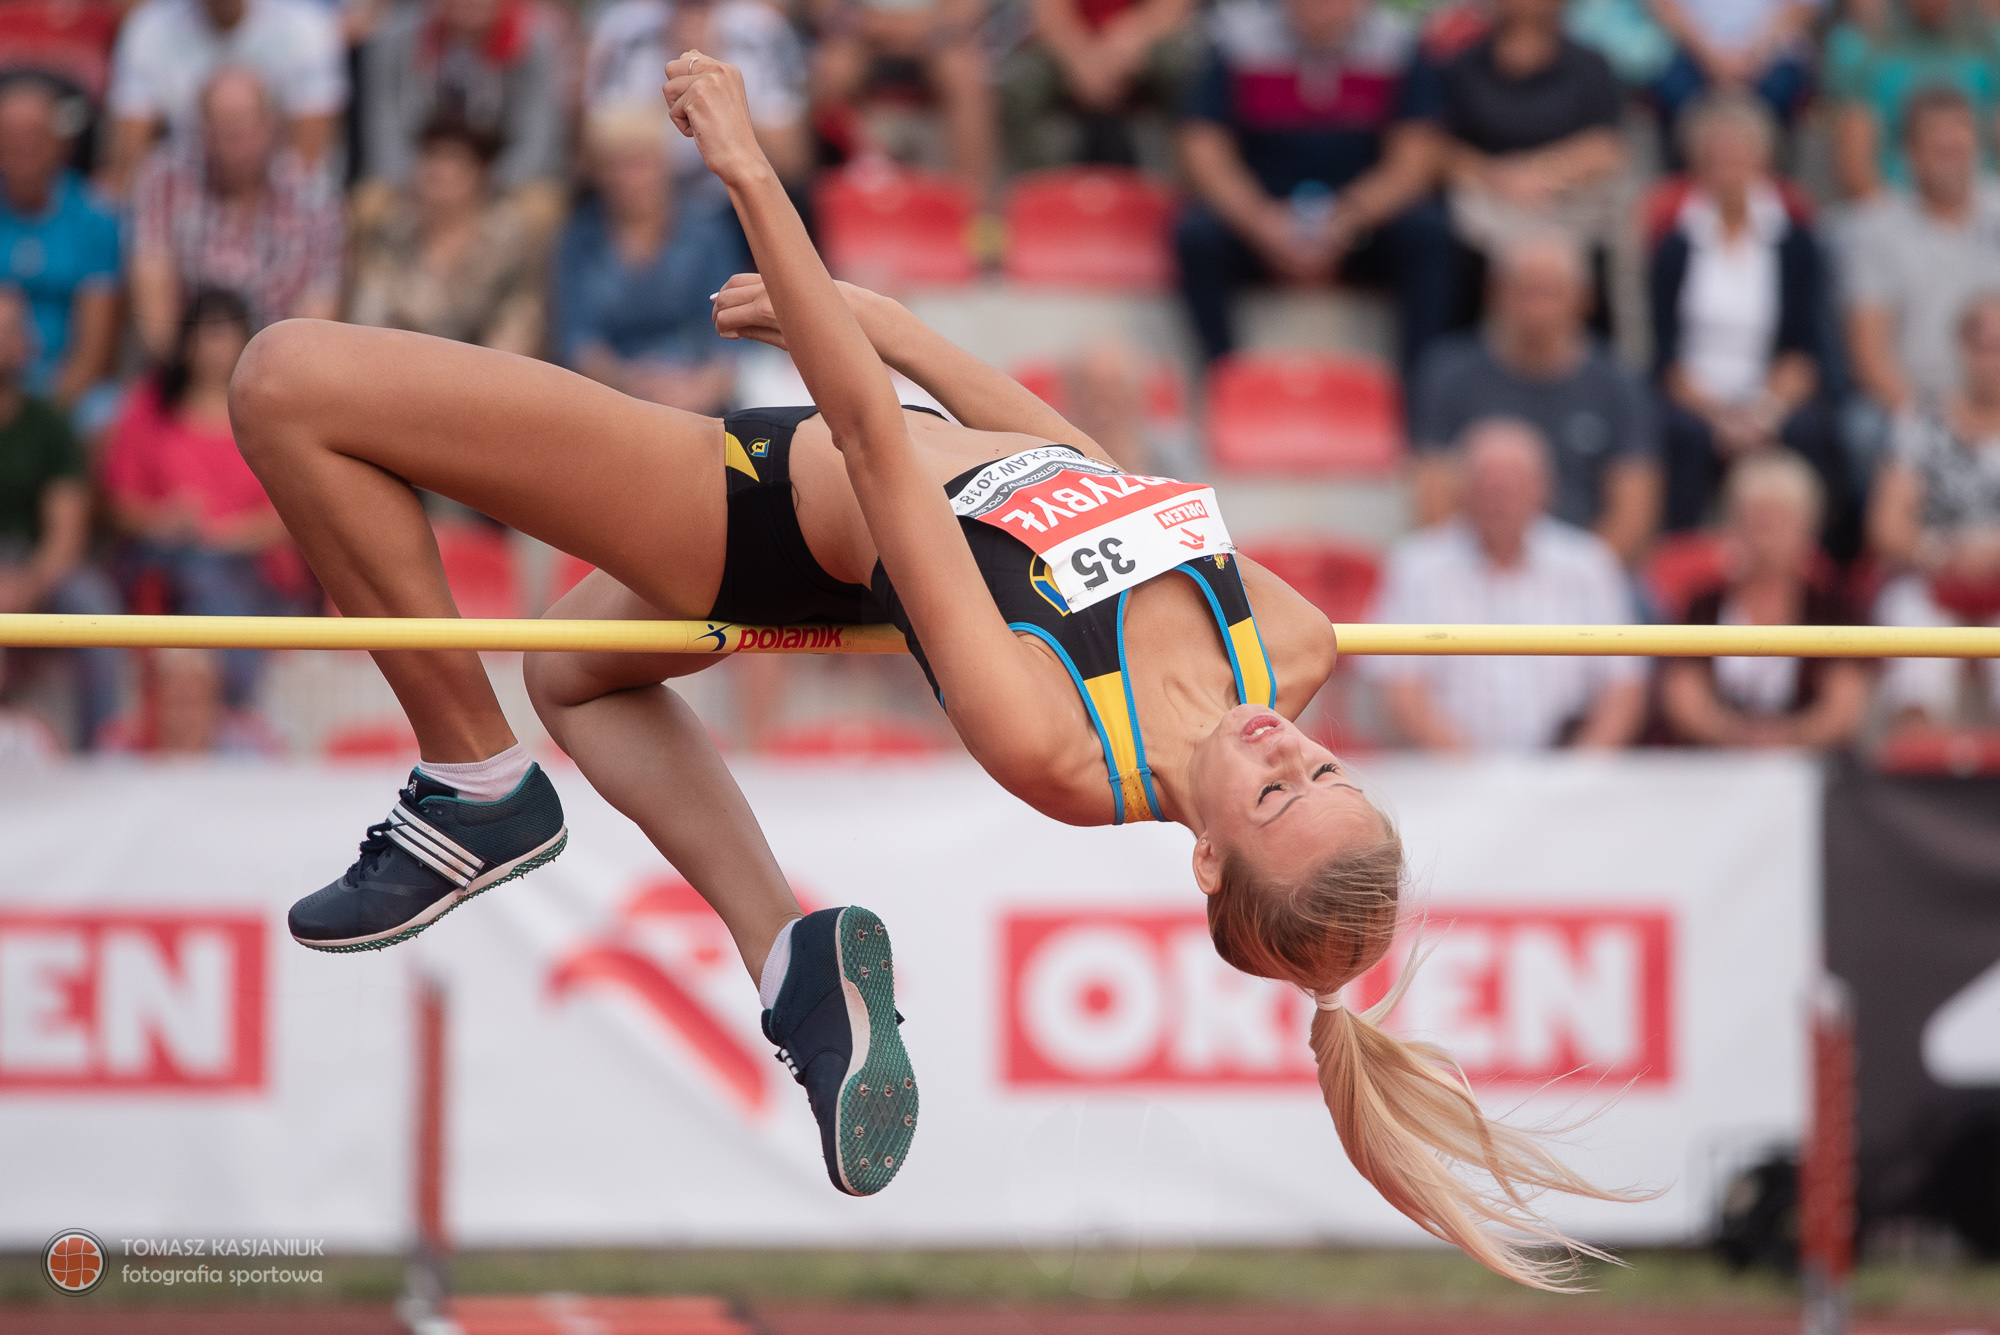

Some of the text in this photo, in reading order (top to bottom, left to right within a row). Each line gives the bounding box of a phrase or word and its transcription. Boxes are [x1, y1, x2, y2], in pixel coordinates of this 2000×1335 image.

[959, 470, 1000, 505] 2018
[1158, 500, 1207, 527] ORLEN
[1071, 537, 1136, 588] 35
[732, 624, 844, 653] polanik
